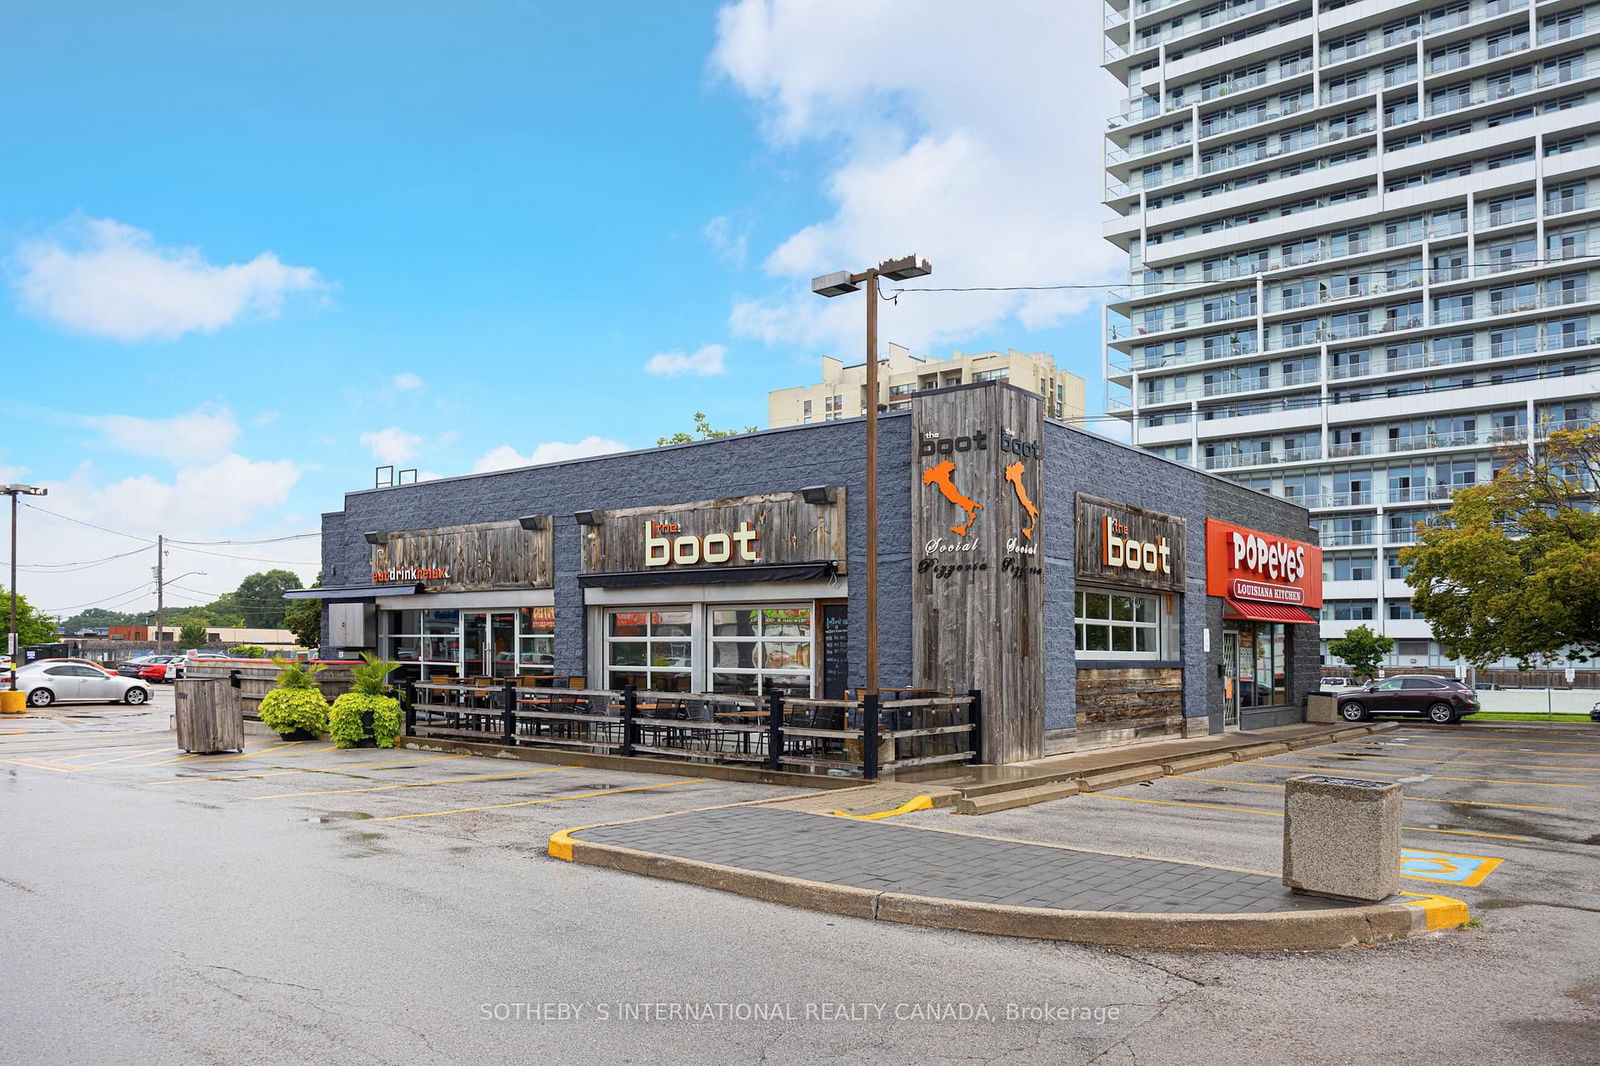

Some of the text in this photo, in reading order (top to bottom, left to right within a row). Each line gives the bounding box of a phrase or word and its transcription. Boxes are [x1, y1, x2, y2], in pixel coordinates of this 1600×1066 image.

[925, 431, 939, 439] the
[1005, 427, 1016, 436] the
[919, 430, 987, 457] boot
[1000, 426, 1042, 460] boot
[656, 521, 681, 533] the
[1113, 519, 1129, 534] the
[645, 520, 760, 567] boot
[925, 537, 979, 556] Social
[1006, 537, 1038, 556] Social
[1102, 515, 1171, 574] boot
[918, 556, 987, 579] Pizzeria
[1237, 583, 1301, 601] LOUISIANA KITCHEN
